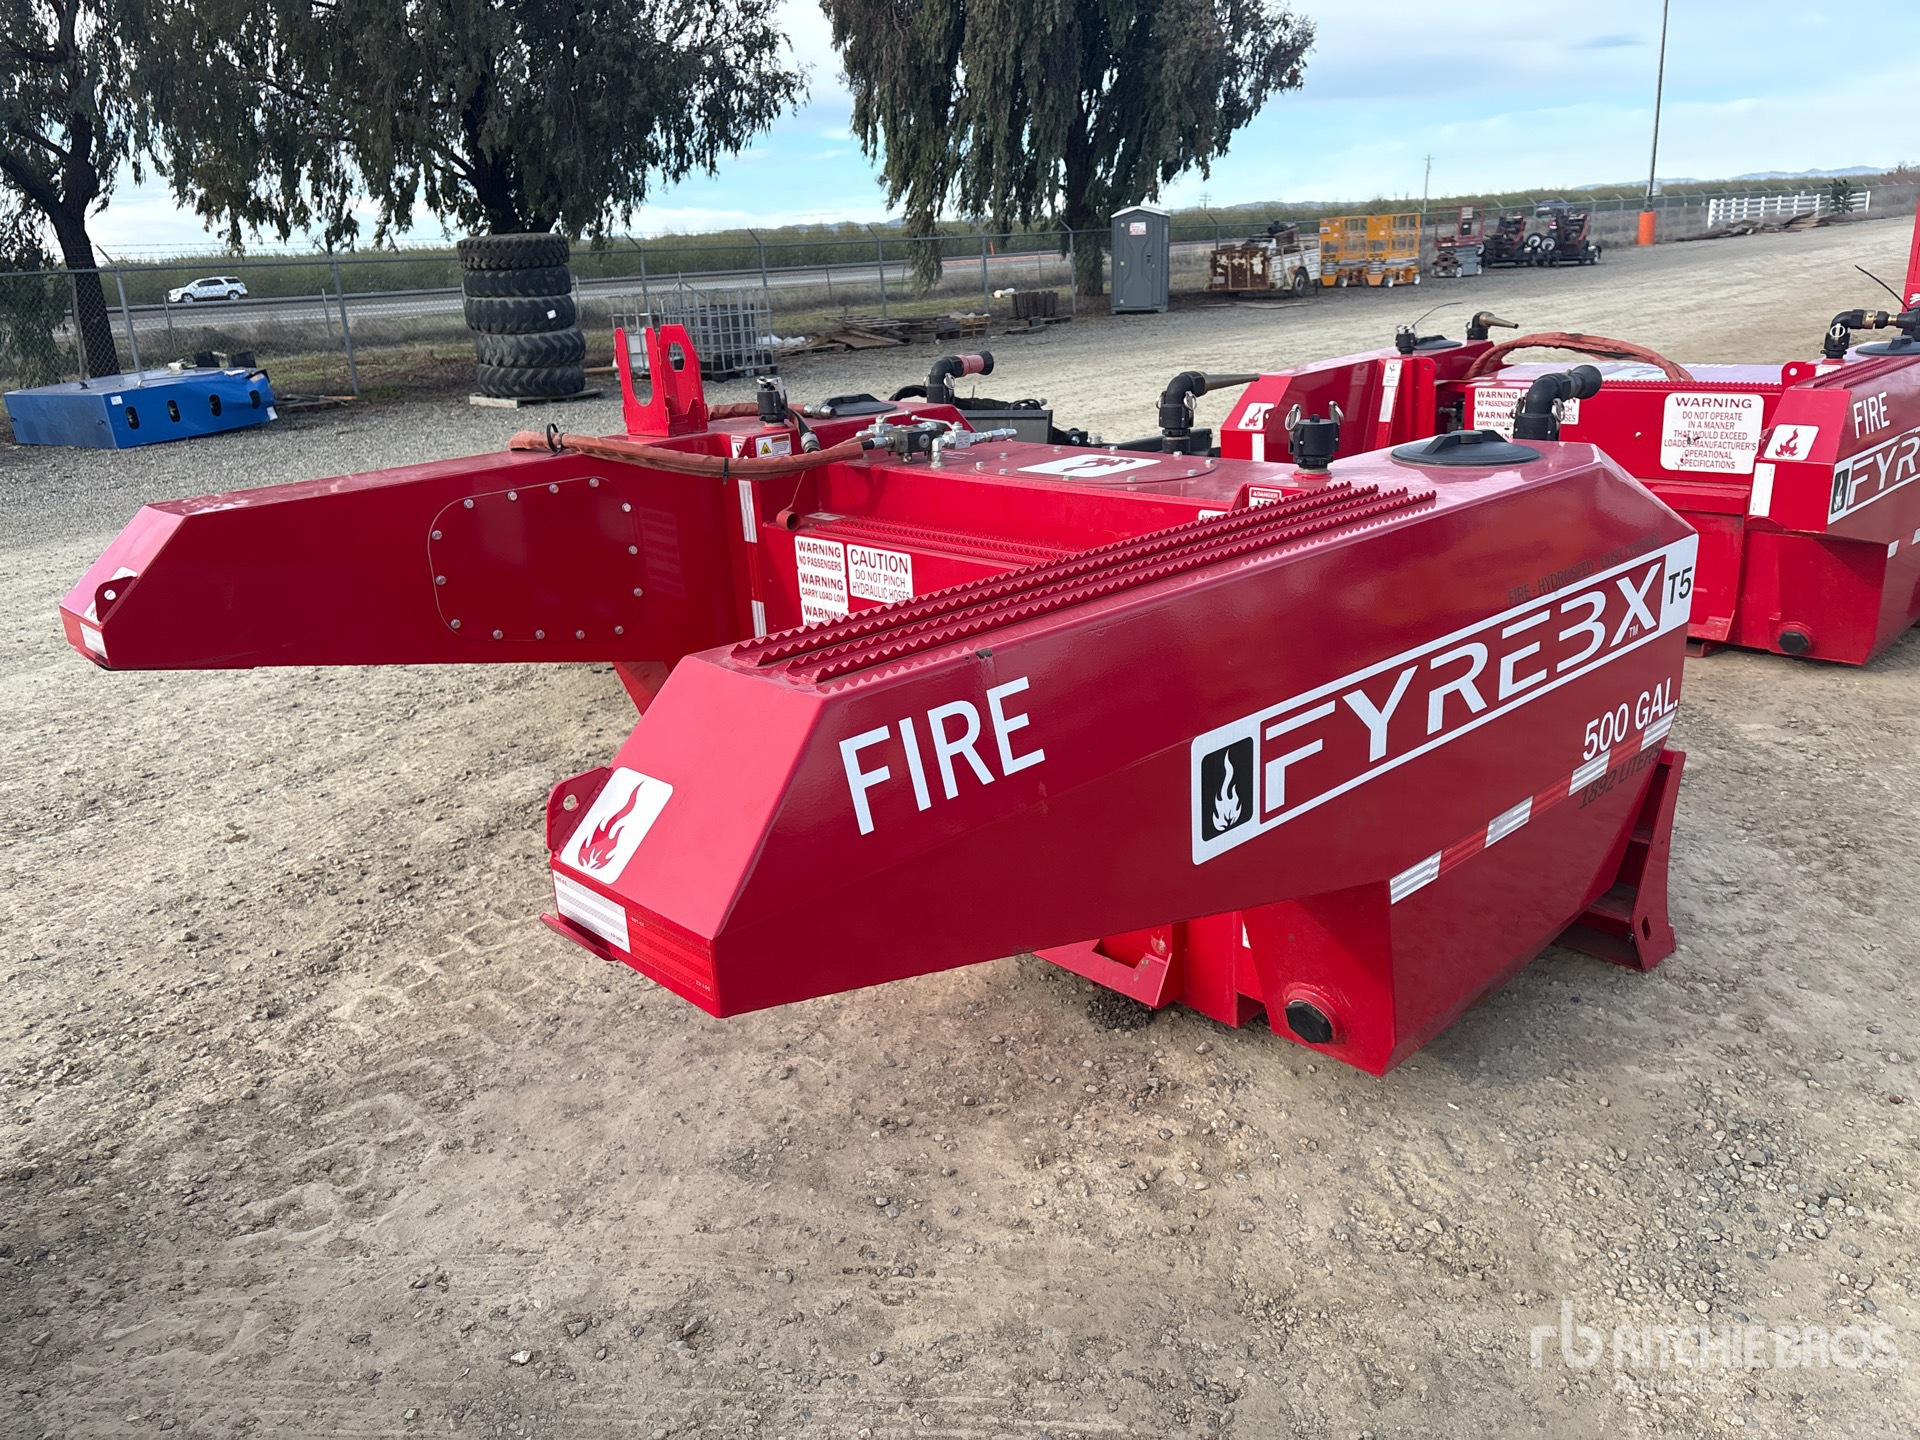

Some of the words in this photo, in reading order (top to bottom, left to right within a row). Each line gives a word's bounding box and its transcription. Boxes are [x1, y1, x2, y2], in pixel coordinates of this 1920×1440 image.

[1477, 391, 1518, 399] WARNING
[1675, 397, 1752, 409] WARNING
[1477, 411, 1511, 419] WARNIN
[1682, 411, 1693, 420] DO
[1694, 411, 1709, 420] NOT
[1710, 412, 1743, 421] OPERATE
[1853, 391, 1890, 439] FIRE
[1688, 421, 1696, 429] IN
[1696, 421, 1702, 429] A
[1703, 421, 1735, 430] MANNER
[1674, 430, 1691, 438] THAT
[1692, 430, 1719, 440] WOULD
[1720, 431, 1748, 441] EXCEED
[1684, 449, 1733, 459] OPERATIONAL
[1680, 459, 1736, 469] SPECIFICATIONS
[797, 540, 842, 559] WARNING
[798, 555, 806, 566] NO
[807, 557, 842, 572] PASSENGERS
[850, 548, 909, 575] CAUTION
[800, 572, 844, 591] WARNING
[855, 569, 866, 581] DO
[867, 572, 881, 583] NOT
[883, 574, 906, 588] PINCH
[1507, 584, 1532, 606] FIRE
[1537, 560, 1595, 596] HYDROSEED
[1667, 566, 1693, 604] T5
[801, 587, 818, 598] CARRY
[818, 591, 832, 601] LOAD
[833, 593, 846, 604] LOW
[852, 581, 888, 599] HYDRAULIC
[1582, 702, 1629, 761] 500
[1635, 677, 1679, 730] GAL.
[838, 676, 1046, 836] FIRE
[1579, 769, 1617, 810] 1892
